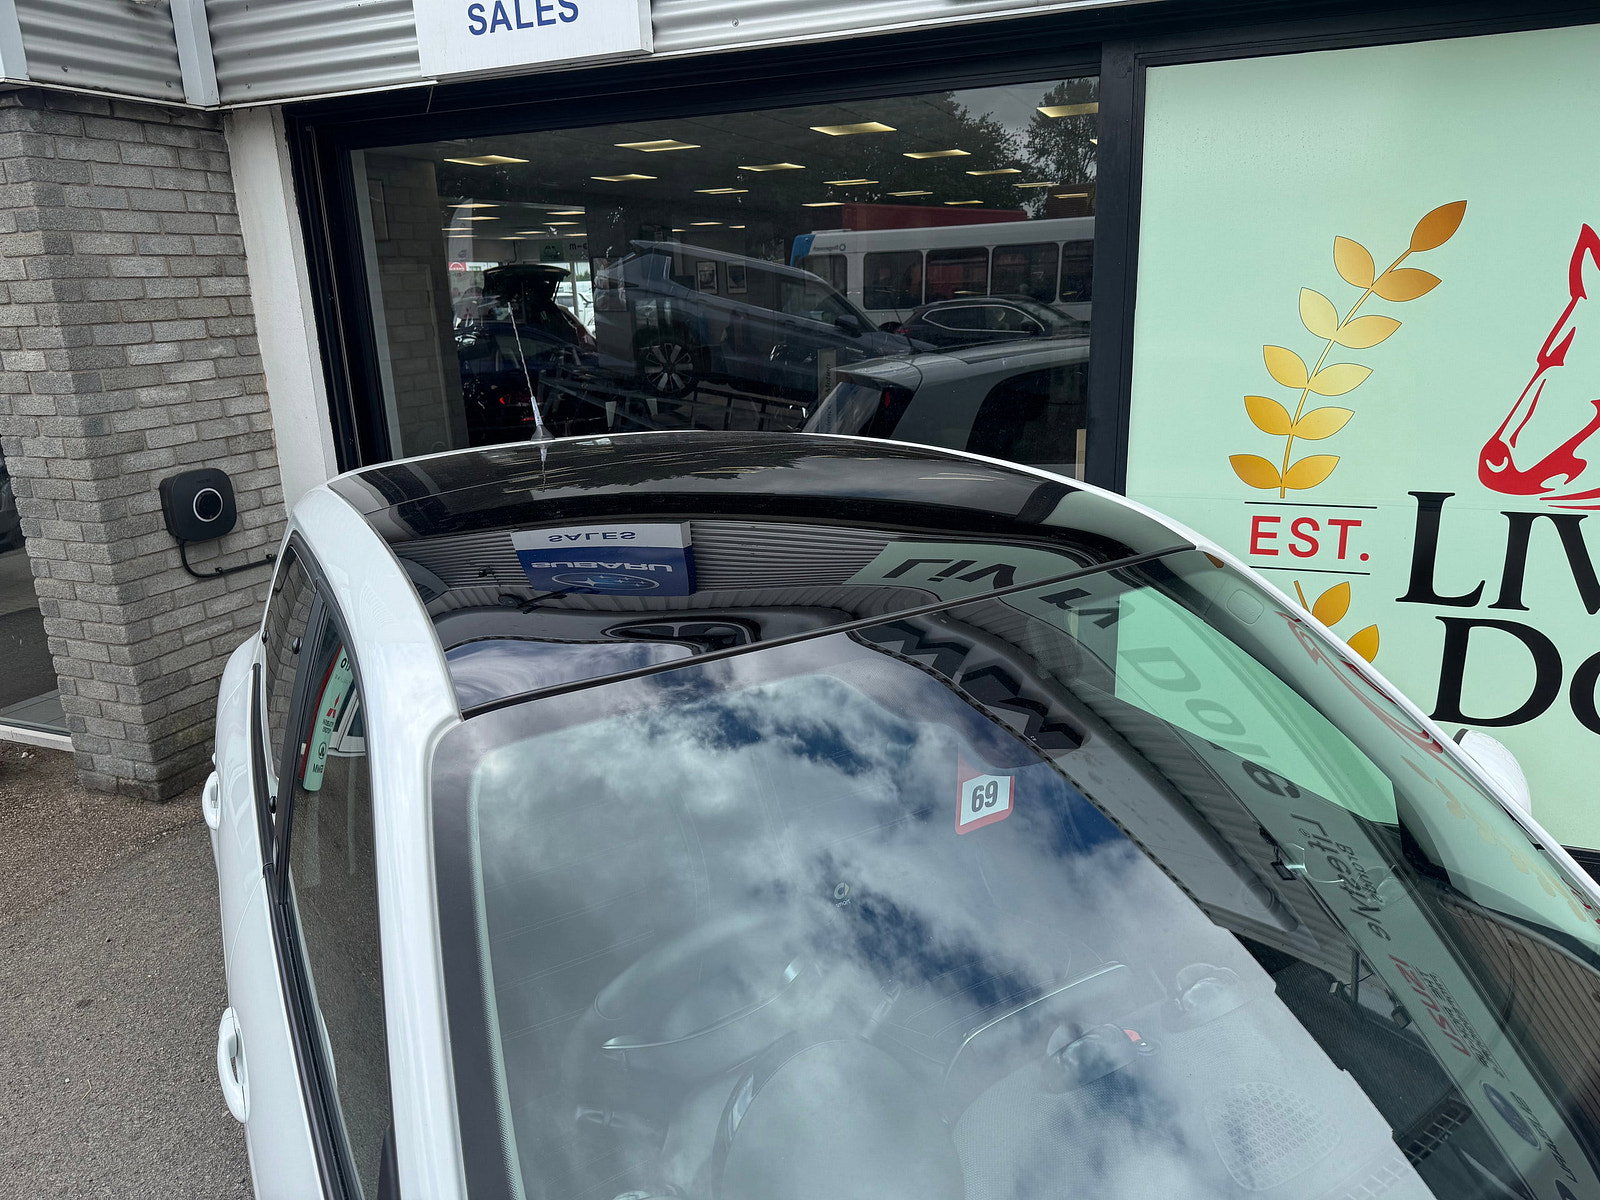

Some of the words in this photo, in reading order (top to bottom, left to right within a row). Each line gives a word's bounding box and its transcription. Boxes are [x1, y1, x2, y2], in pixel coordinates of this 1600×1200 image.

[467, 0, 579, 36] SALES
[1249, 515, 1370, 562] EST.
[971, 780, 999, 813] 69
